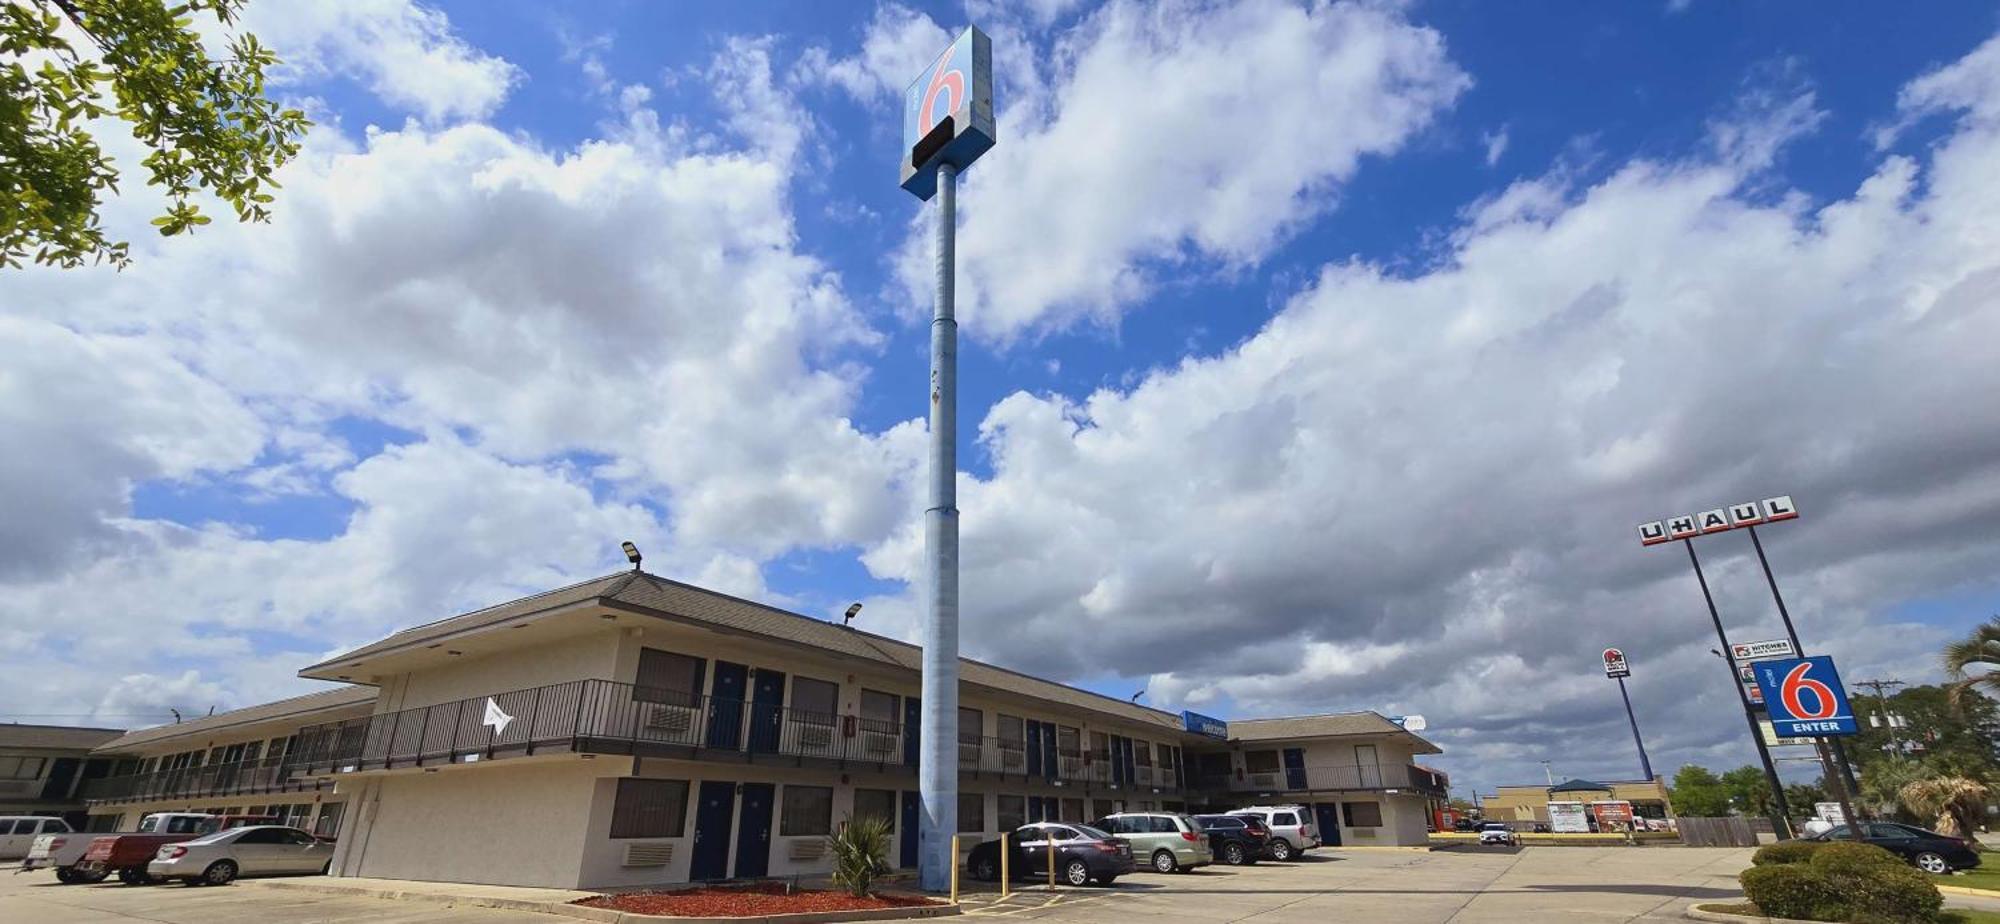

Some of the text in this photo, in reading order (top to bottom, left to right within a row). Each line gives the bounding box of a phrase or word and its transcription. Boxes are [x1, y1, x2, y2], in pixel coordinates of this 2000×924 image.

[918, 44, 964, 139] 6
[1642, 501, 1789, 538] UHAUL
[1781, 662, 1837, 720] 6
[1792, 722, 1840, 732] ENTER
